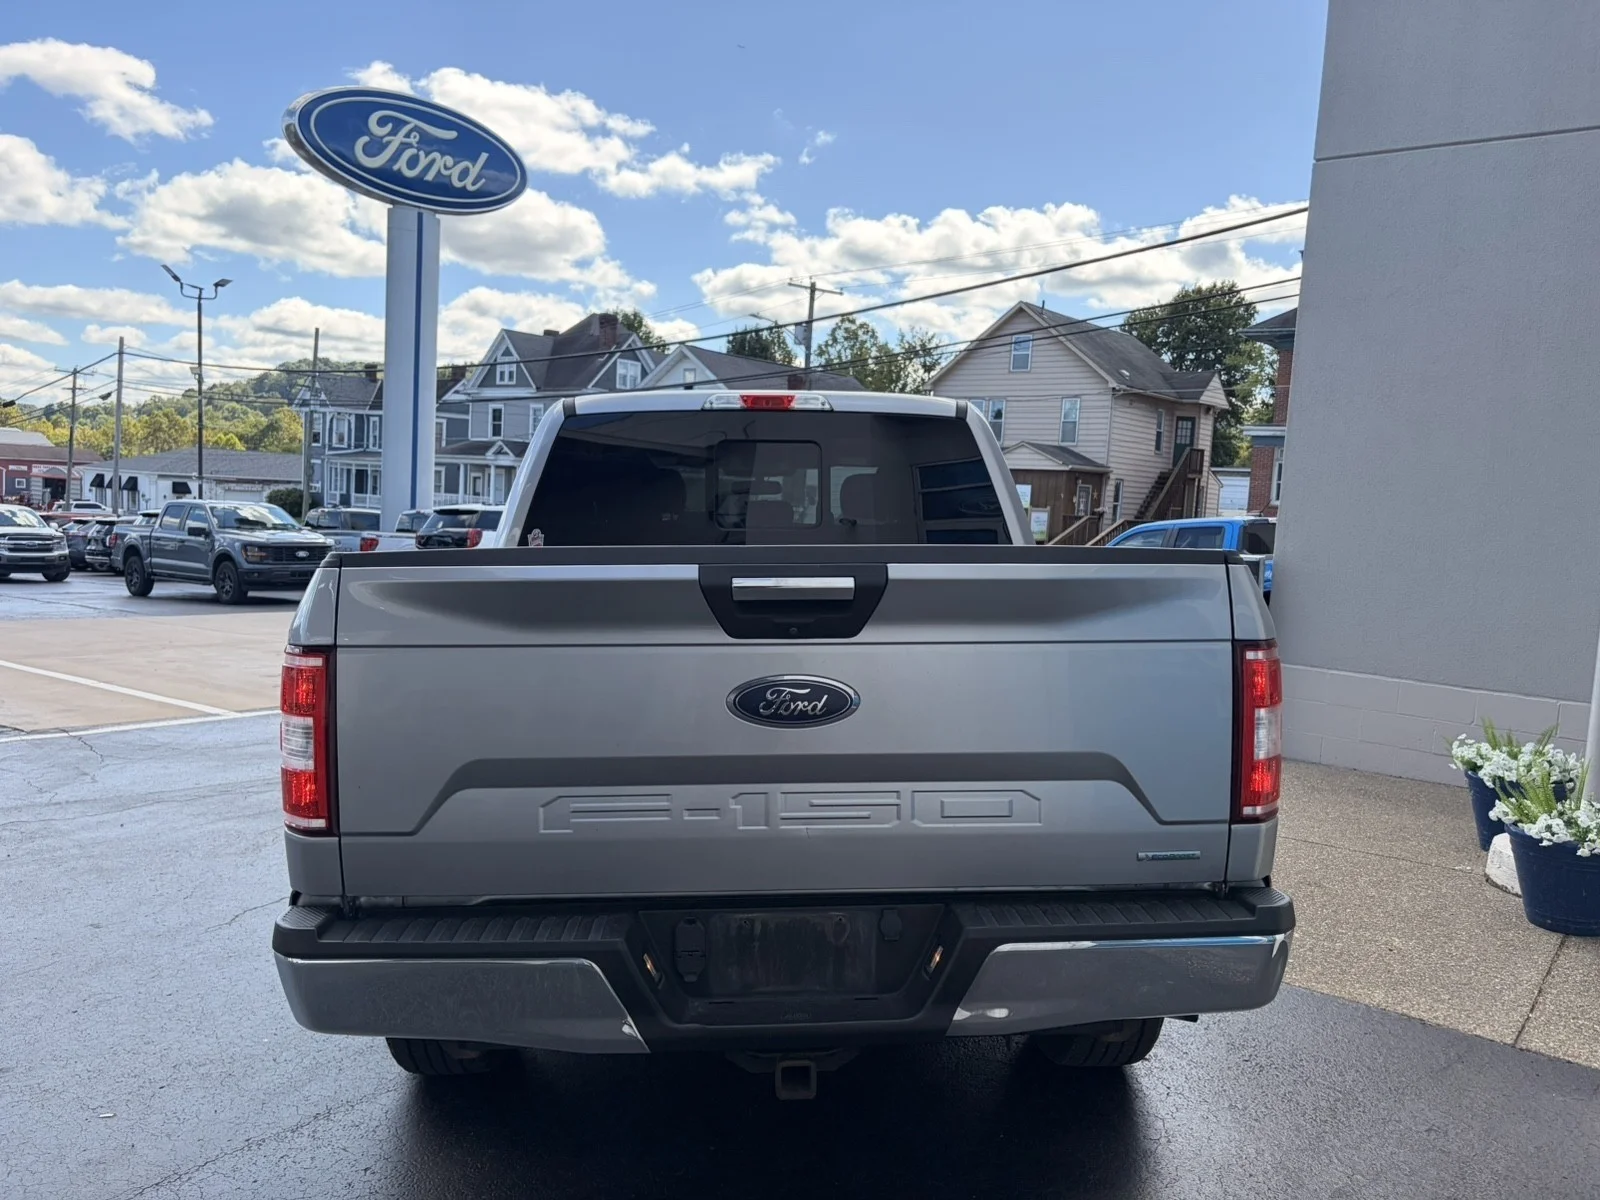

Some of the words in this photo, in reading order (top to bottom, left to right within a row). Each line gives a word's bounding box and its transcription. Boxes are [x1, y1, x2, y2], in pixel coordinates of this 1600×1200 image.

[354, 110, 489, 192] Ford
[758, 687, 829, 716] Ford
[538, 789, 1043, 833] F-150
